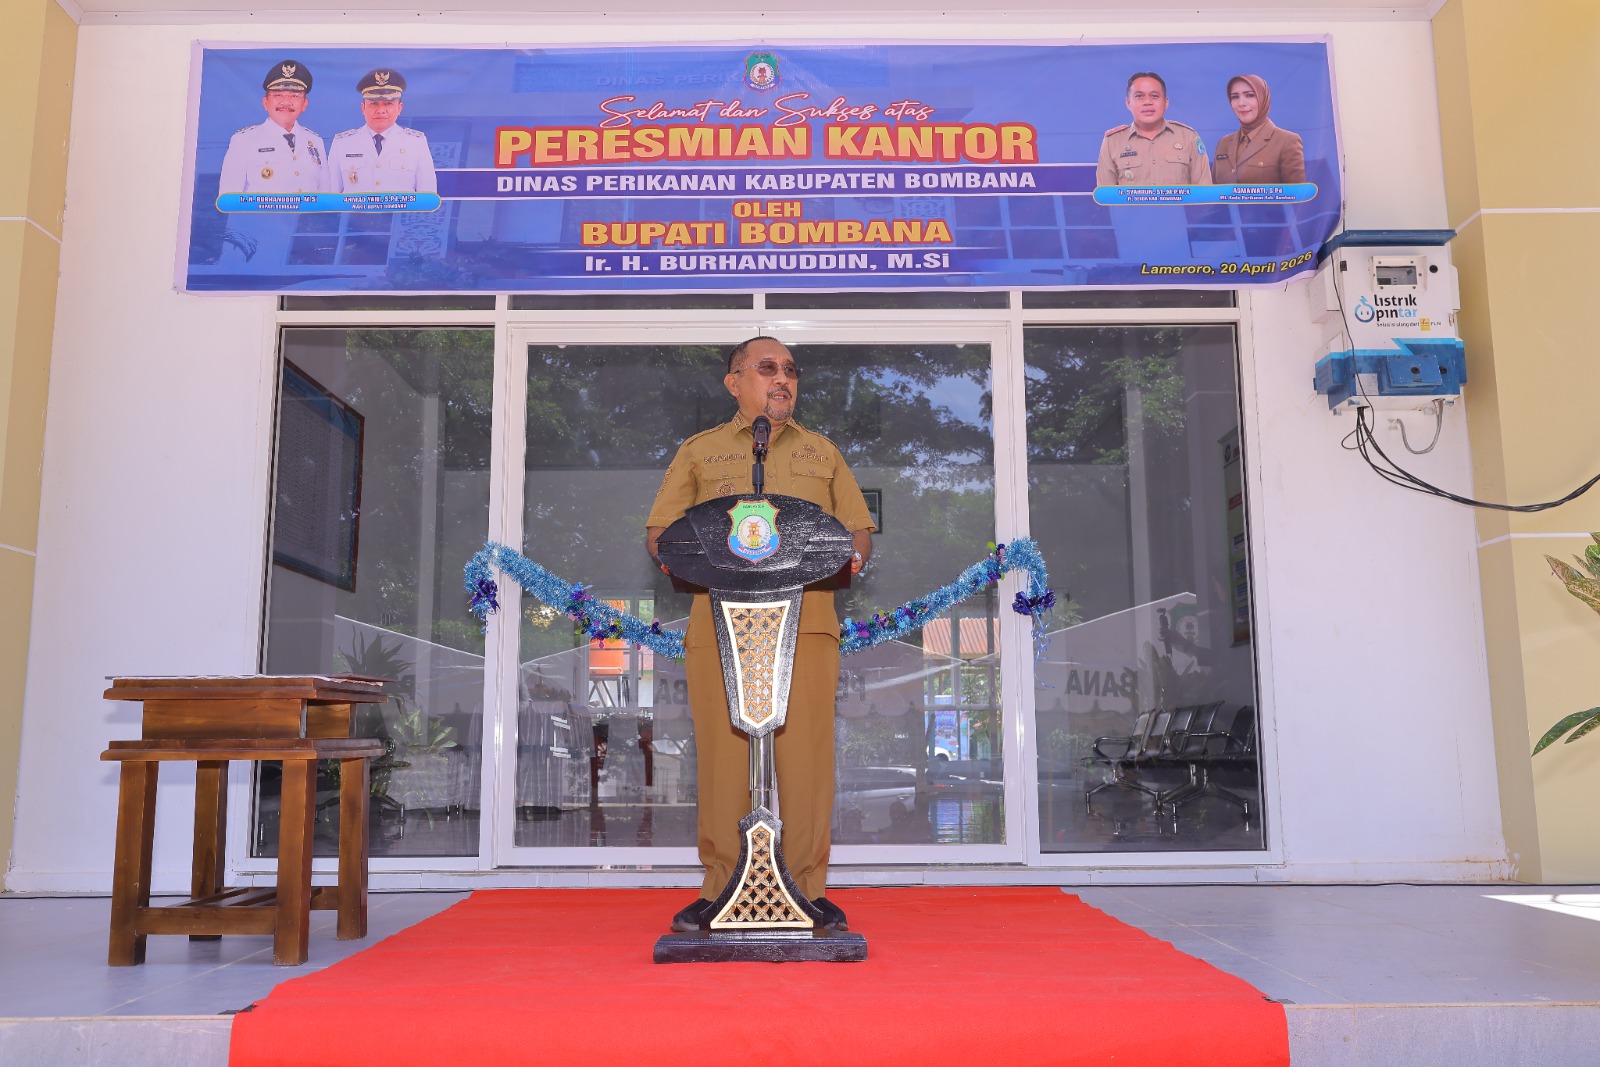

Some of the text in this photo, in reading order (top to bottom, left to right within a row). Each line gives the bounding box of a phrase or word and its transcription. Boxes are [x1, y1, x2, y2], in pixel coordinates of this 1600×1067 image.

[599, 92, 934, 128] Selamat dan Sukses atas
[497, 125, 1036, 166] PERESMIAN KANTOR
[497, 172, 1036, 192] DINAS PERIKANAN KABUPATEN BOMBANA
[733, 202, 802, 218] OLEH
[582, 220, 953, 246] BUPATI BOMBANA
[585, 252, 950, 272] Ir. H. BURHANUDDIN, M.Si
[1141, 251, 1312, 276] Lameroro, 20 April 2026
[1374, 294, 1417, 306] listrik
[1376, 307, 1417, 322] pintar
